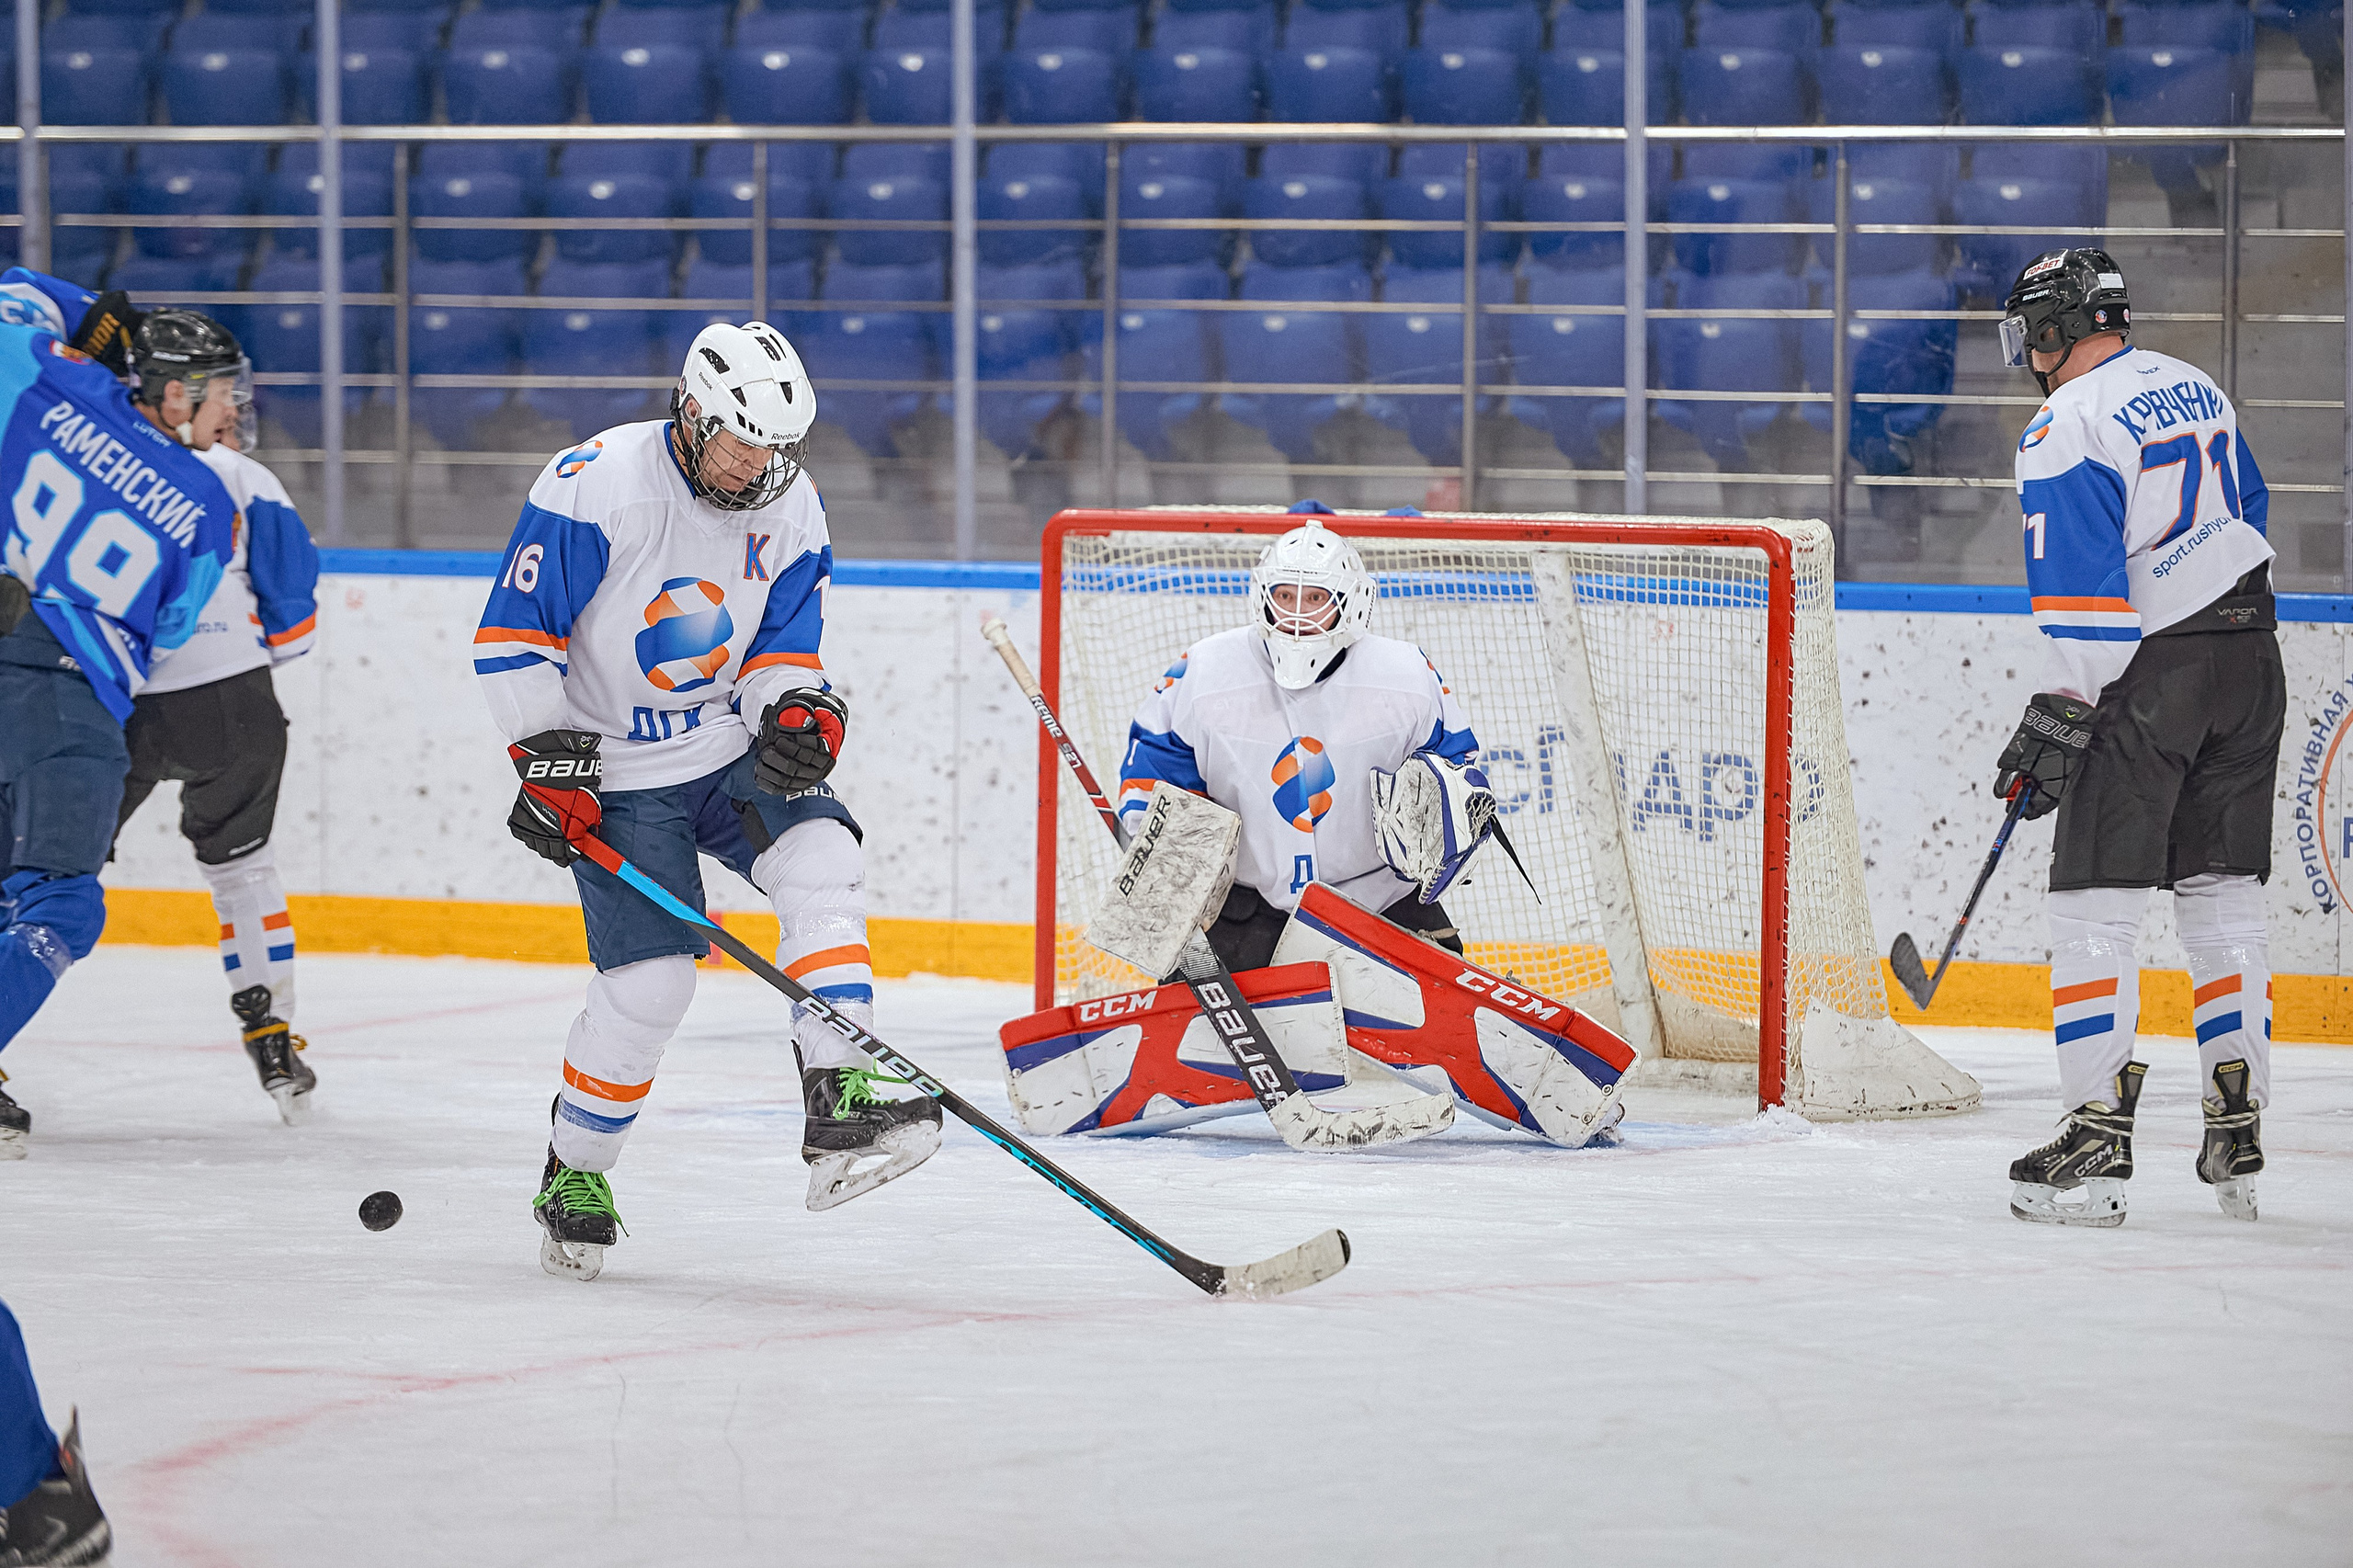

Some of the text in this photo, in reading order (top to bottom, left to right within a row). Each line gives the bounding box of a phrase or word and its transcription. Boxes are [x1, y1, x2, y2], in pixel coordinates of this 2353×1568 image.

[698, 371, 714, 392] Reebok
[770, 431, 802, 440] Reebok
[40, 400, 207, 549] РАМЕНСКИЙ
[2140, 428, 2241, 551] 71
[4, 449, 163, 619] 99
[2022, 511, 2046, 560] 1
[2152, 517, 2232, 578] sport.rushyd
[502, 540, 544, 594] 16
[813, 574, 831, 619] 1
[1030, 694, 1063, 739] REME
[2022, 707, 2093, 749] BAUE
[2296, 690, 2349, 915] КОРПОРАТИВНАЯ
[1119, 793, 1172, 897] BAUER
[1079, 990, 1158, 1023] CCM
[1455, 967, 1562, 1022] CCM
[2074, 1144, 2114, 1178] CCM
